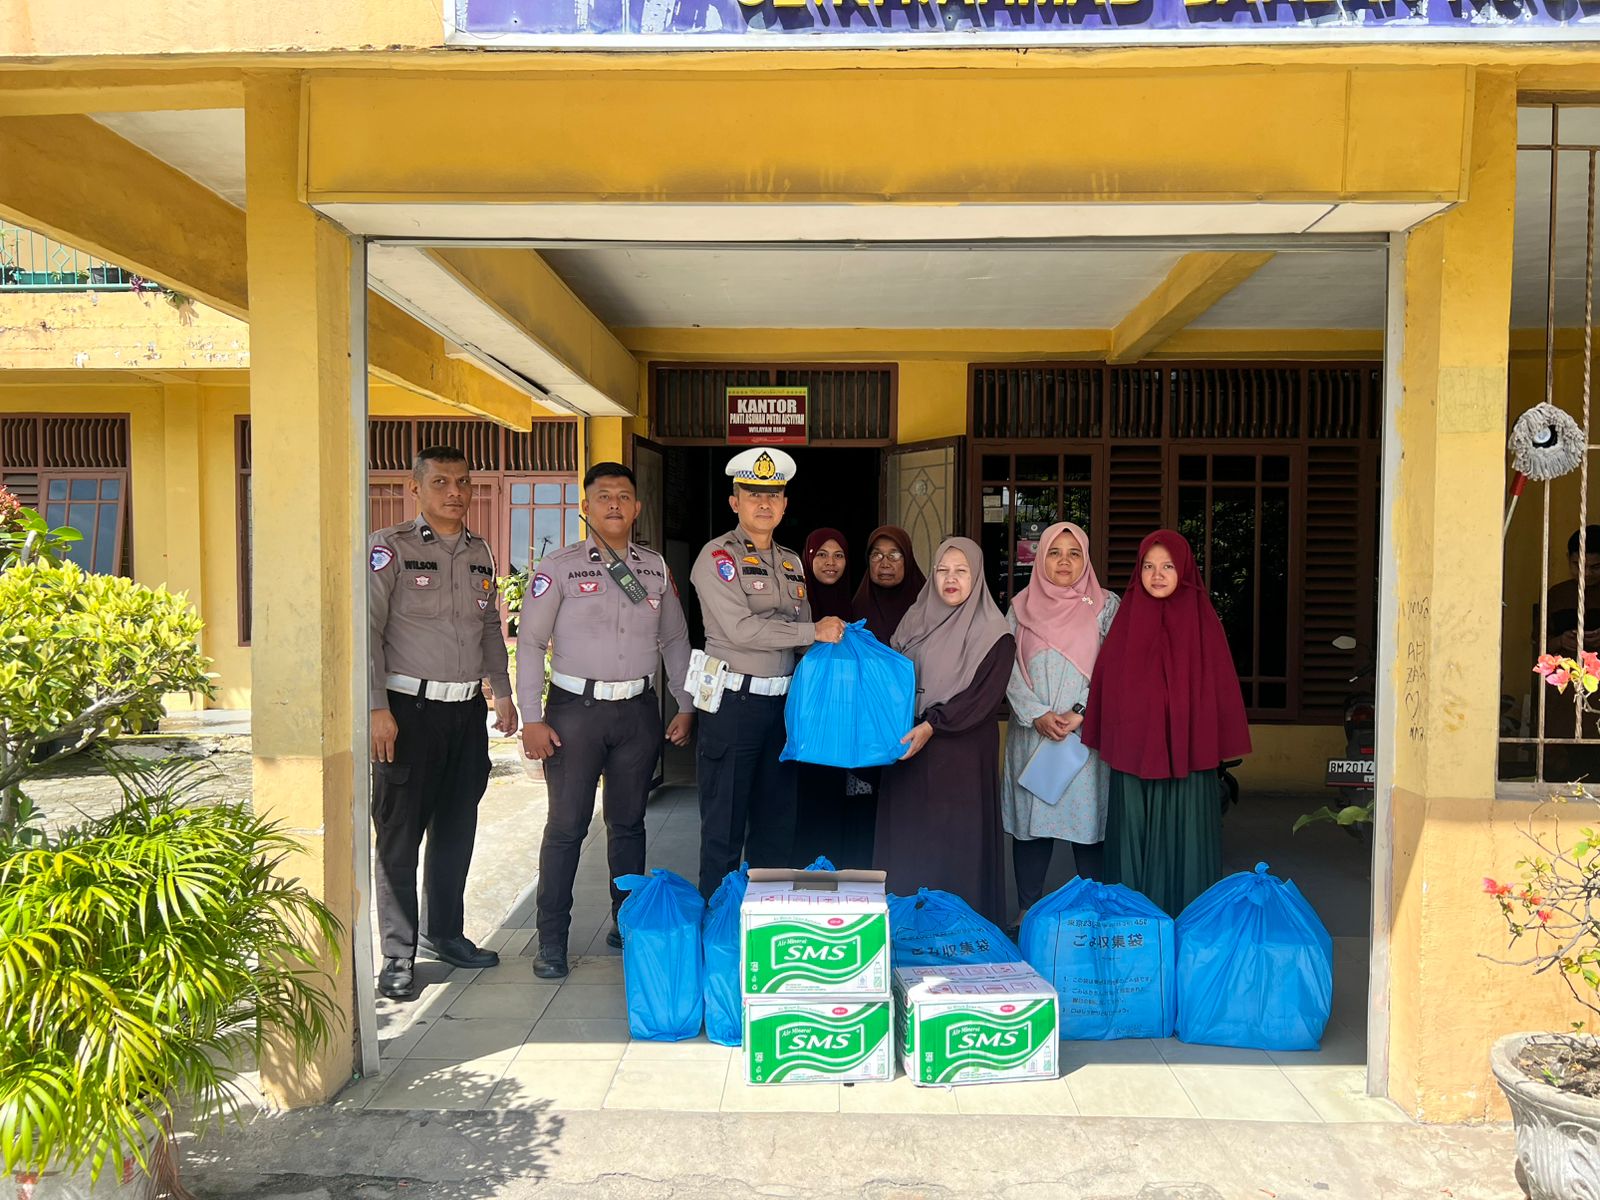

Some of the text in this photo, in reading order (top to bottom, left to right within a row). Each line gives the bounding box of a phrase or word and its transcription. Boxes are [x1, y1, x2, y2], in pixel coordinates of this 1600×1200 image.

[737, 399, 797, 413] KANTOR
[729, 413, 745, 425] PANTI
[745, 413, 765, 425] ASUHAN
[404, 560, 438, 571] WILSON
[567, 569, 603, 579] ANGGA
[777, 937, 787, 947] Air
[783, 945, 848, 961] SMS
[781, 1027, 812, 1037] Air Mineral
[951, 1026, 981, 1037] Air Mineral
[788, 1033, 852, 1050] SMS
[957, 1031, 1019, 1049] SMS
